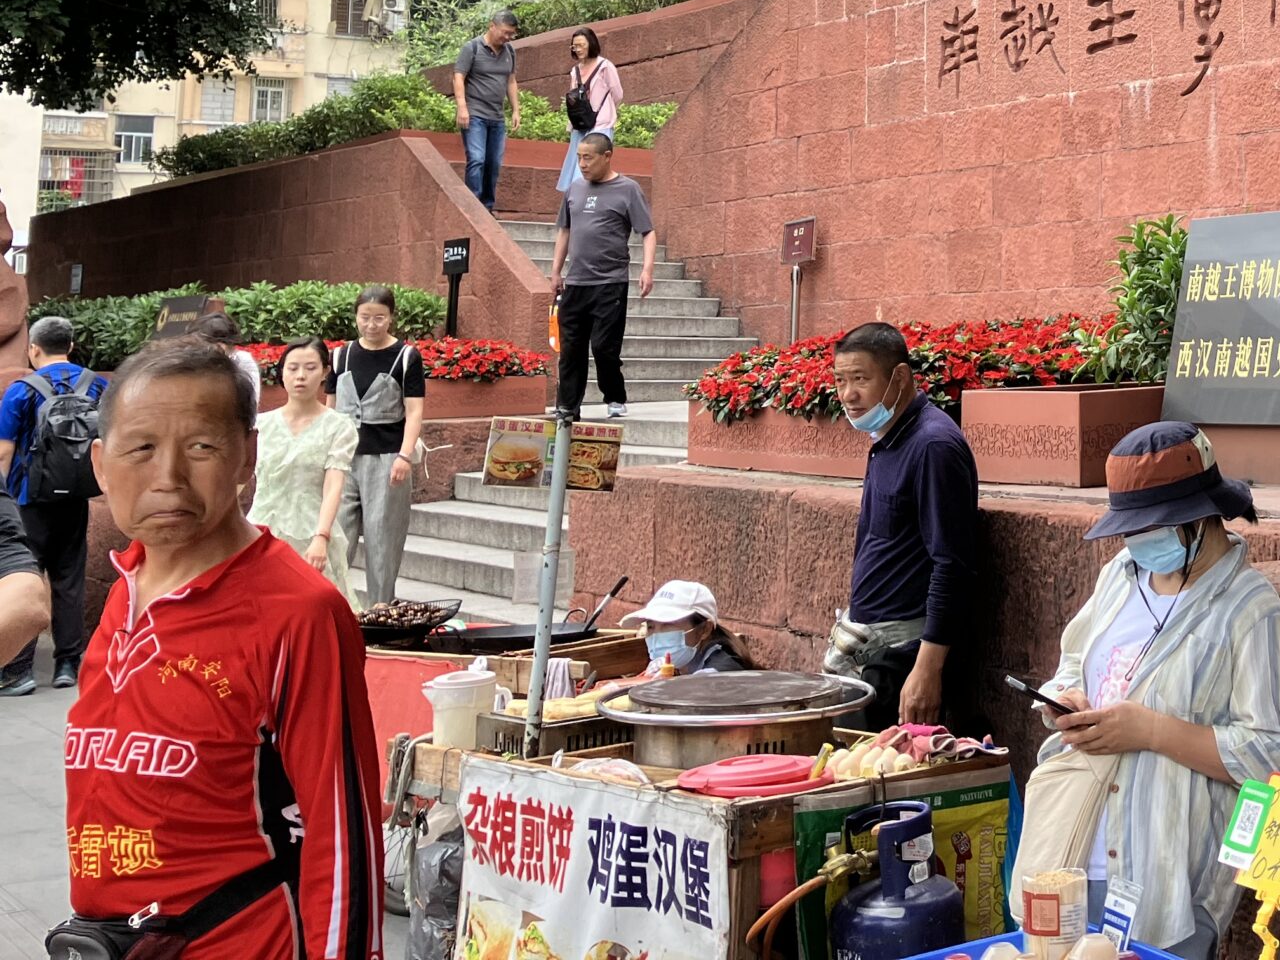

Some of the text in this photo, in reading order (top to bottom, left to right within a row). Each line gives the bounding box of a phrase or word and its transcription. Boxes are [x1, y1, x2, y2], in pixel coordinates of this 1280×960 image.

[495, 420, 545, 434] 鸡蛋汉堡
[157, 652, 232, 700] 河南安阳
[64, 723, 198, 778] ORLAD
[464, 786, 575, 894] 杂粮煎饼
[586, 812, 714, 930] 鸡蛋汉堡
